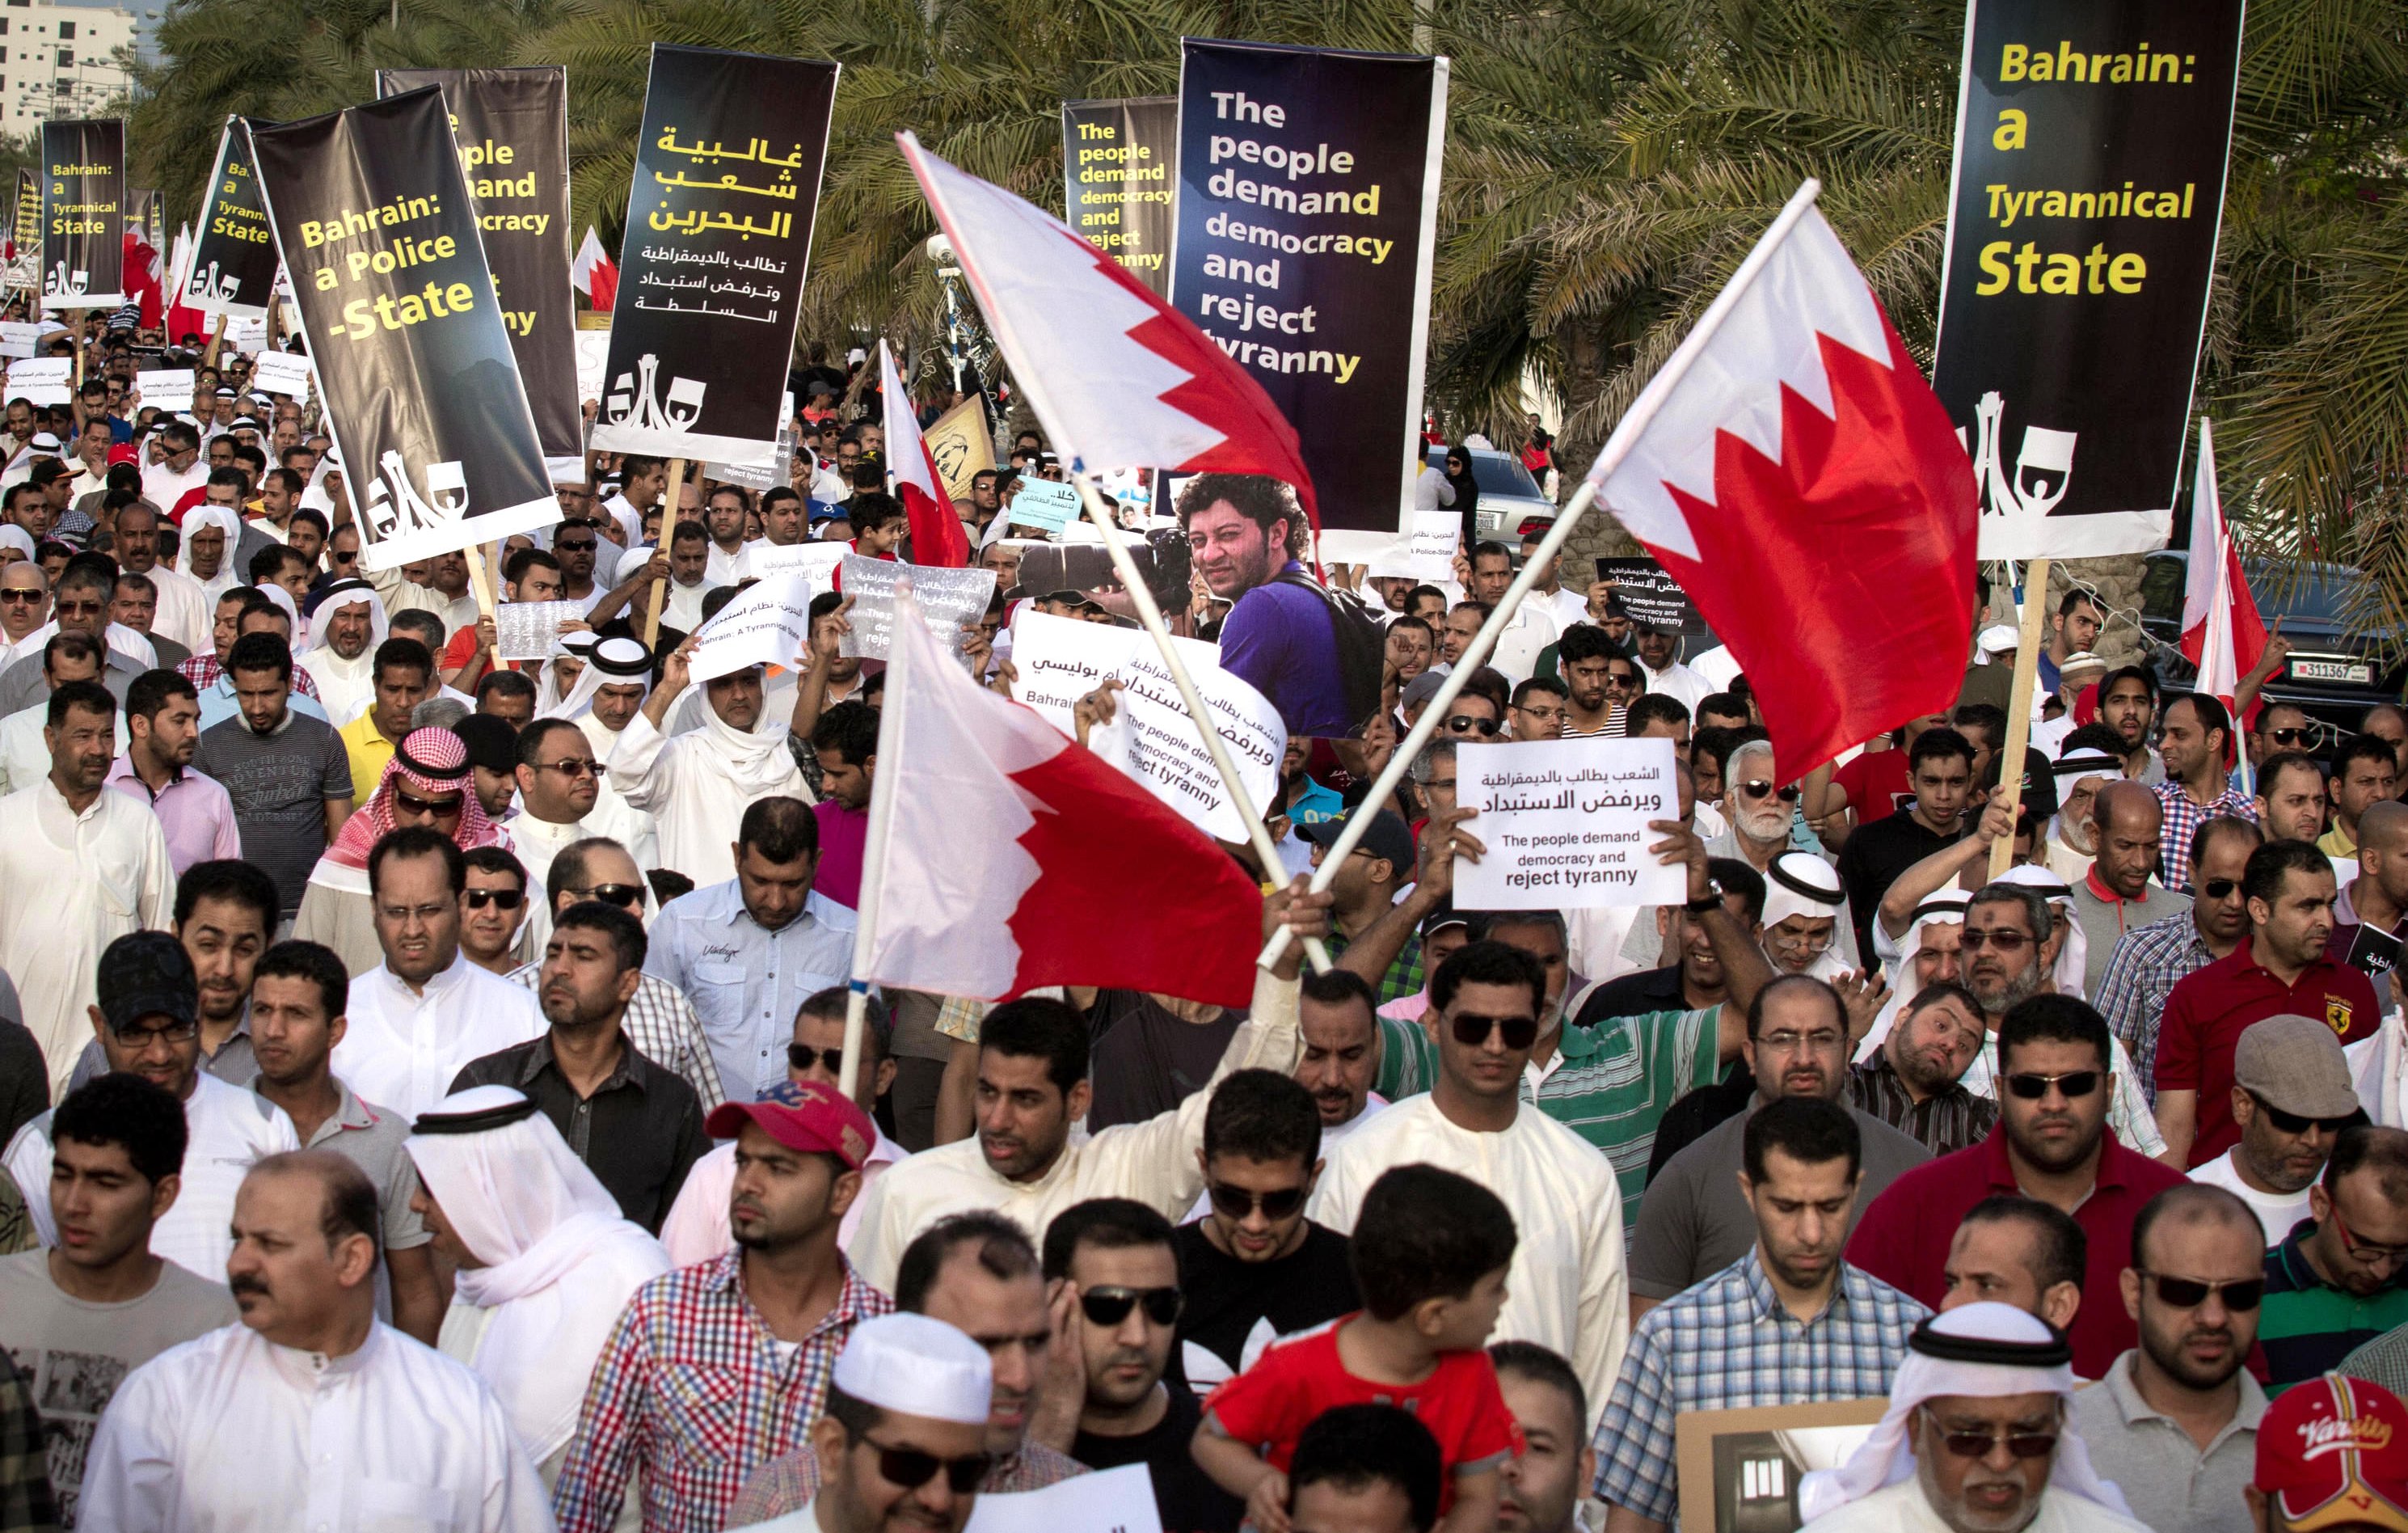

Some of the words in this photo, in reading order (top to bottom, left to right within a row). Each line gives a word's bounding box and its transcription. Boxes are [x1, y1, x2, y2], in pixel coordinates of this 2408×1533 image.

[2000, 40, 2195, 83] Bahrain:
[1210, 91, 1286, 128] The
[1077, 123, 1115, 140] The
[1992, 108, 2028, 151] a
[657, 126, 802, 168] غالبية
[1079, 142, 1151, 166] people
[1209, 135, 1355, 180] people
[53, 163, 112, 176] Bahrain:
[1080, 163, 1165, 183] demand
[53, 183, 64, 195] a
[223, 181, 237, 194] a
[655, 169, 798, 200] شعب
[1208, 168, 1380, 215] demand
[52, 202, 116, 215] Tyrannical
[1080, 190, 1174, 205] democracy
[1985, 181, 2195, 227] Tyrannical
[52, 219, 105, 235] State
[300, 194, 441, 248] Bahrain:
[649, 201, 792, 241] البحرين
[1082, 208, 1120, 226] and
[212, 217, 269, 243] State
[1205, 212, 1394, 264] democracy
[315, 267, 339, 291] a
[346, 235, 456, 282] Police
[641, 246, 730, 268] بالديمقراطية
[734, 256, 787, 274] تطالب
[1976, 241, 2147, 296] State
[639, 272, 707, 290] استبداد
[1203, 252, 1280, 289] and
[711, 279, 781, 302] وترفض
[329, 281, 474, 340] -State
[635, 296, 778, 324] السلطة
[1200, 293, 1317, 335] reject
[724, 467, 746, 478] reject
[747, 472, 774, 484] tyranny
[1619, 595, 1631, 603] The
[1633, 598, 1655, 606] people
[1657, 599, 1685, 607] demand
[1648, 615, 1683, 627] tyranny
[1032, 658, 1099, 677] بوليسي
[2308, 663, 2349, 679] 311367
[1204, 695, 1242, 721] يطالب
[1127, 713, 1145, 730] The
[1146, 726, 1189, 751] people
[1243, 716, 1281, 749] الشعب
[1217, 724, 1275, 766] ويرفض
[1195, 771, 1220, 789] and
[1482, 770, 1562, 789] بالديمقراطية
[1567, 768, 1609, 785] يطالب
[1613, 766, 1659, 782] الشعب
[1159, 766, 1221, 811] tyranny
[1482, 790, 1575, 815] الاستبداد
[1583, 791, 1661, 813] ويرفض
[1502, 834, 1528, 847] The
[1532, 834, 1579, 851] people
[1583, 830, 1640, 846] demand
[1518, 854, 1595, 868] democracy
[1600, 851, 1626, 863] and
[1507, 869, 1559, 889] reject
[1566, 868, 1638, 888] tyranny
